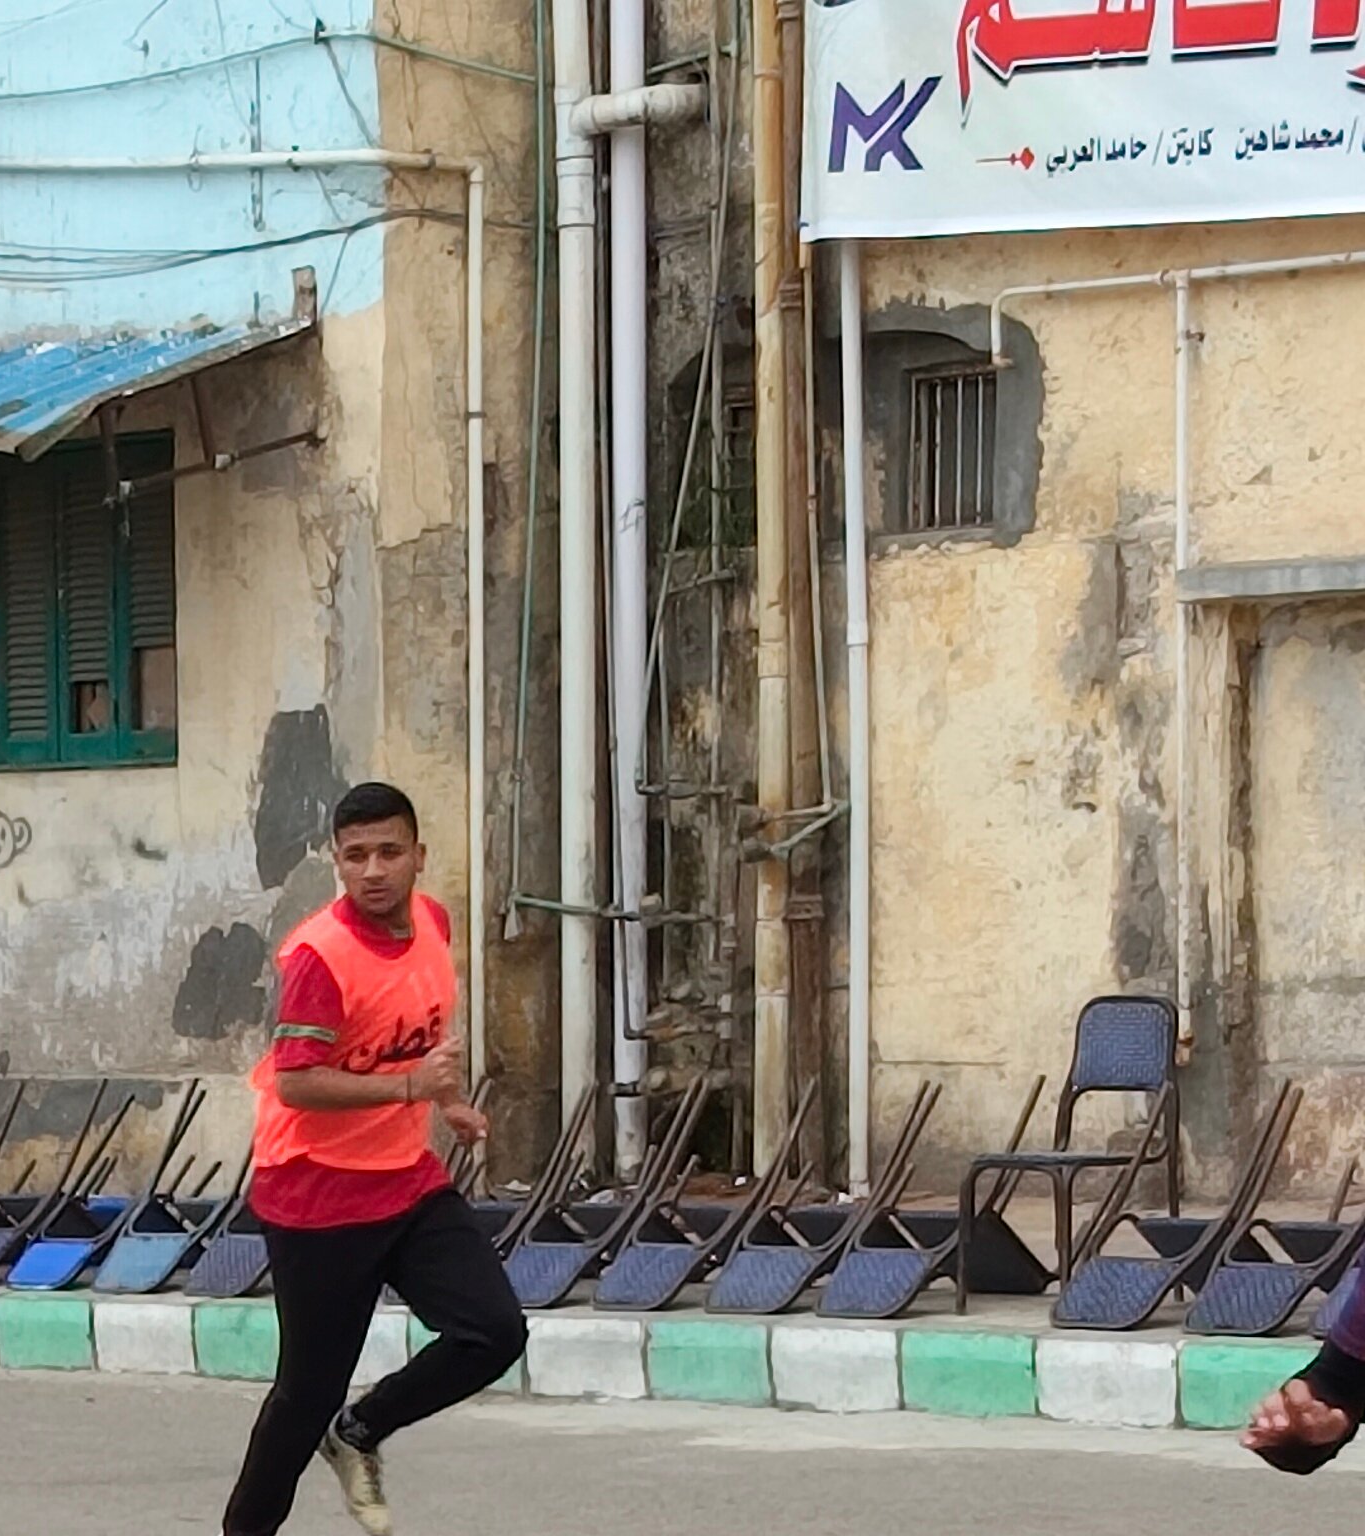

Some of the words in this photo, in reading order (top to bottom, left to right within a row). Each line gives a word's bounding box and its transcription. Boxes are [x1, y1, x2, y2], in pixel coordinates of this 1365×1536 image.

[828, 75, 943, 172] MK
[1234, 119, 1290, 160] شاهين
[1046, 136, 1101, 178] العربي
